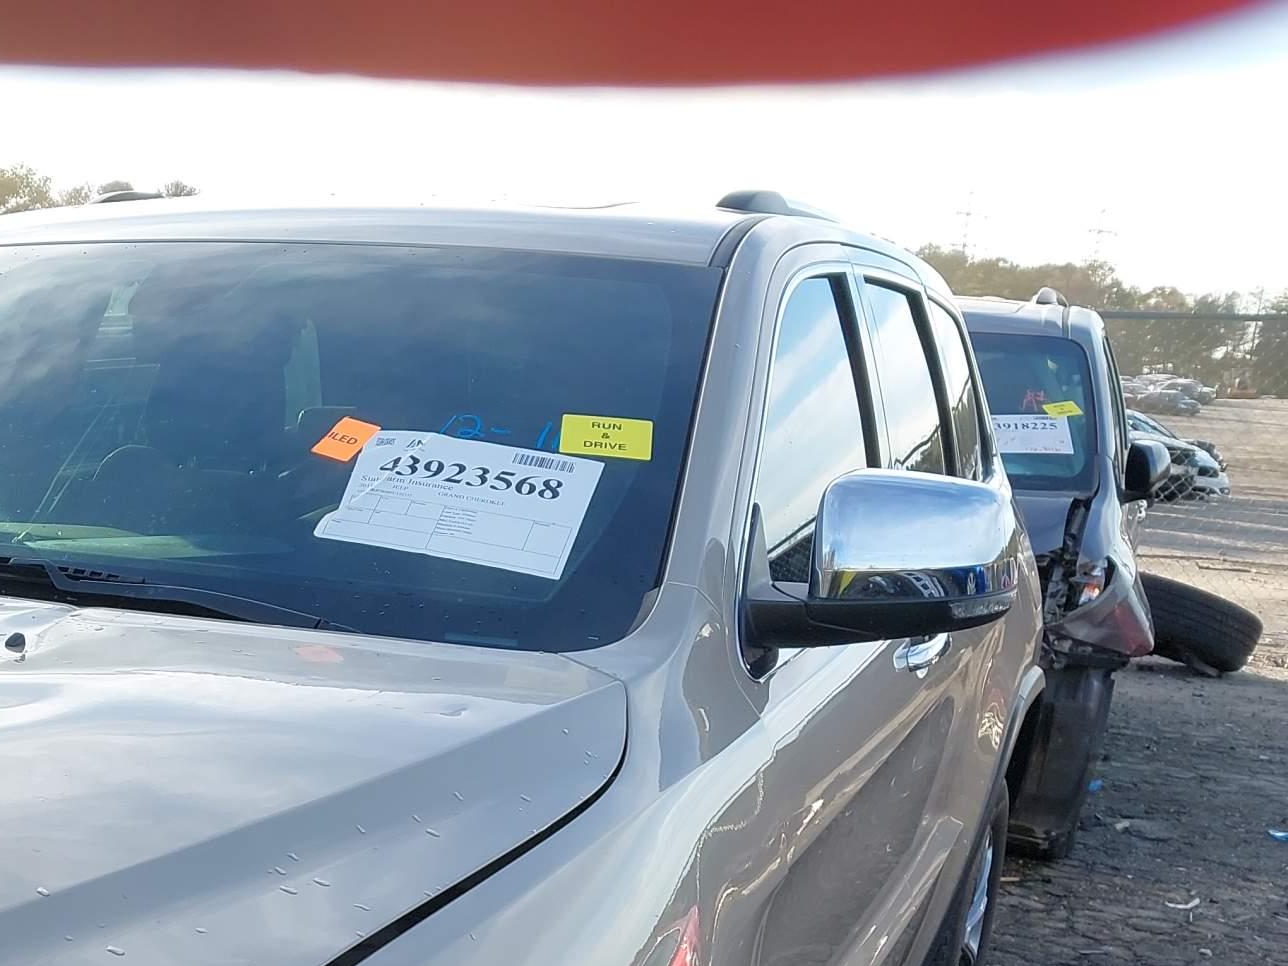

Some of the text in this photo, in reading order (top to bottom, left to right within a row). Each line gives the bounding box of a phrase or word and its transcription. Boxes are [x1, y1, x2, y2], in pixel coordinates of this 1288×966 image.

[591, 421, 623, 431] RUN
[601, 432, 611, 440] &
[583, 440, 628, 451] DRIVE
[379, 454, 564, 500] 43923568
